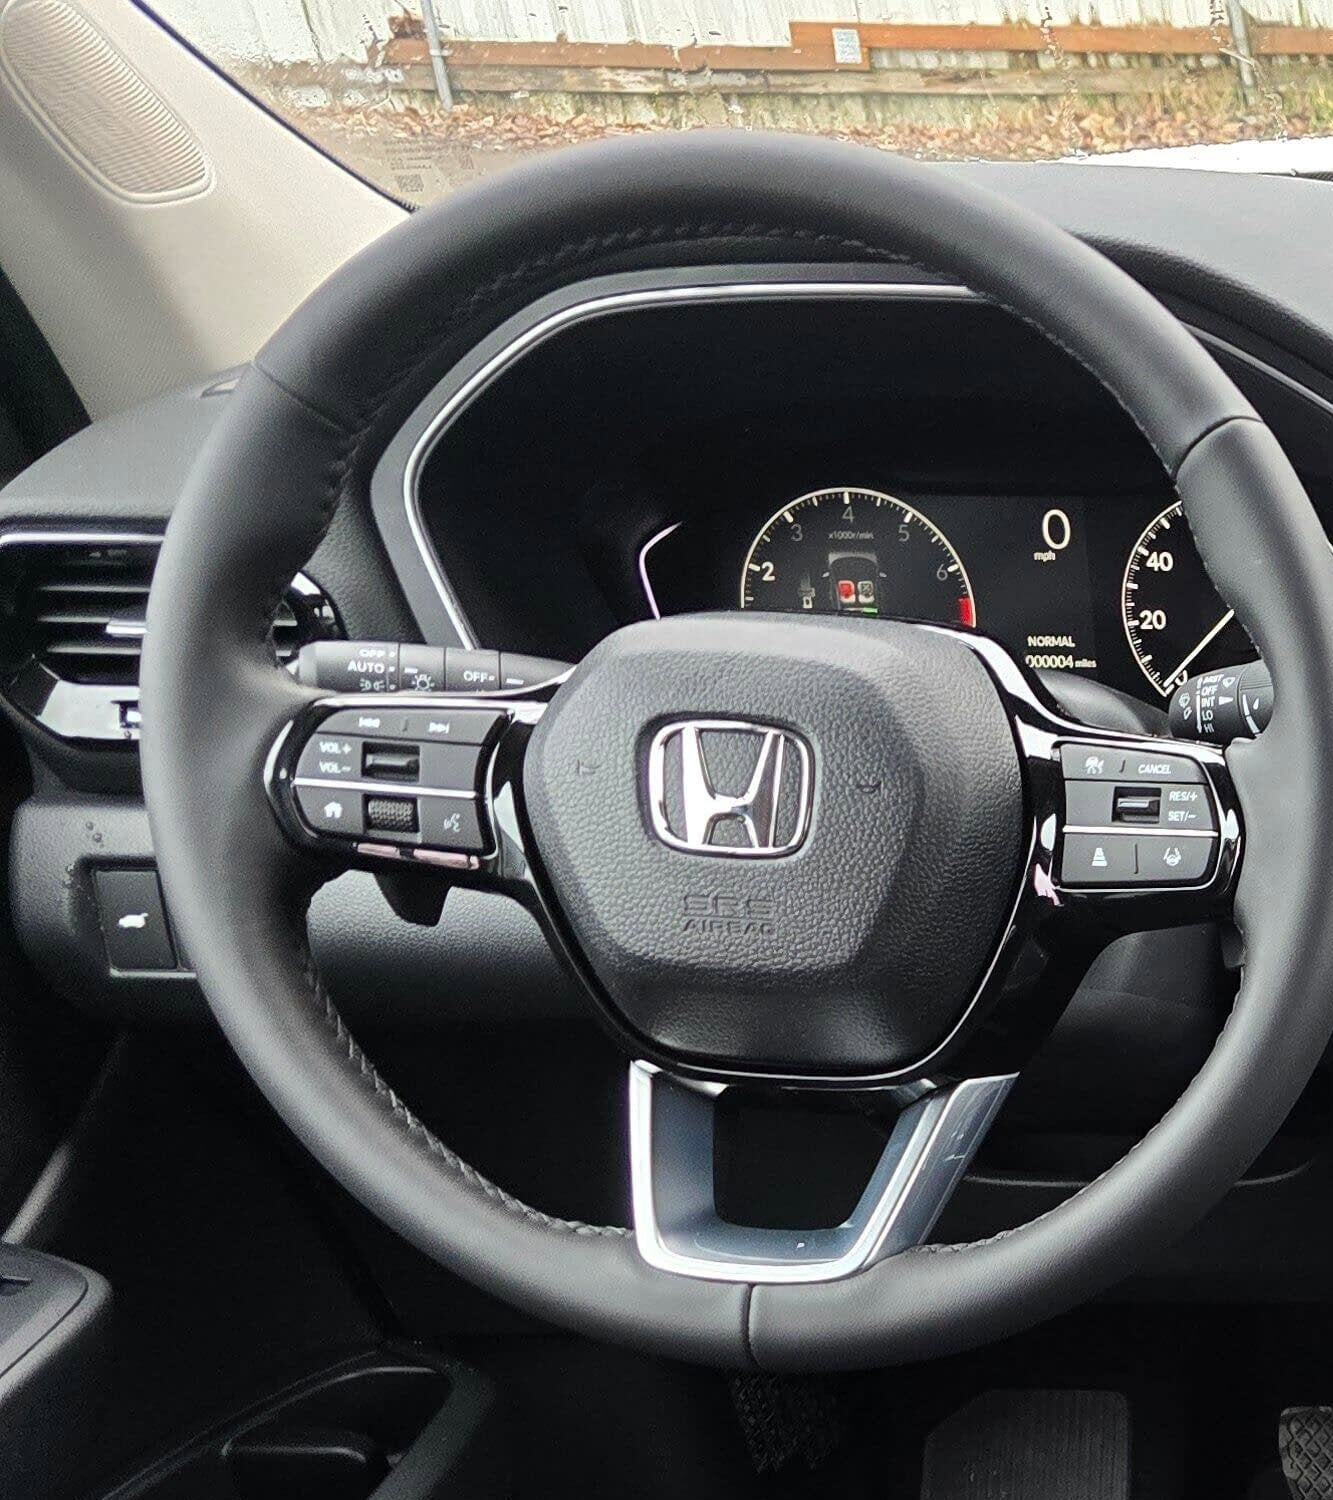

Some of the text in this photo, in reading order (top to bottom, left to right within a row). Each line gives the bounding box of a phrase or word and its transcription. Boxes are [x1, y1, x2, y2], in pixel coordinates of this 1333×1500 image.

[841, 506, 855, 523] 4
[791, 525, 803, 542] 3
[899, 525, 910, 542] 5
[1042, 509, 1071, 550] 0
[1033, 551, 1056, 562] mph
[1146, 551, 1173, 572] 40
[761, 562, 775, 581] 2
[936, 564, 948, 581] 6
[1140, 609, 1166, 630] 20
[1027, 636, 1075, 647] NORMAL
[359, 648, 385, 658] OFF
[348, 661, 385, 674] AUTO
[1025, 655, 1097, 670] 000004 miles
[463, 671, 487, 682] OFF
[1202, 685, 1218, 695] OFF
[1202, 710, 1213, 721] LO
[1204, 723, 1215, 733] HI
[1138, 763, 1171, 775] CANCEL
